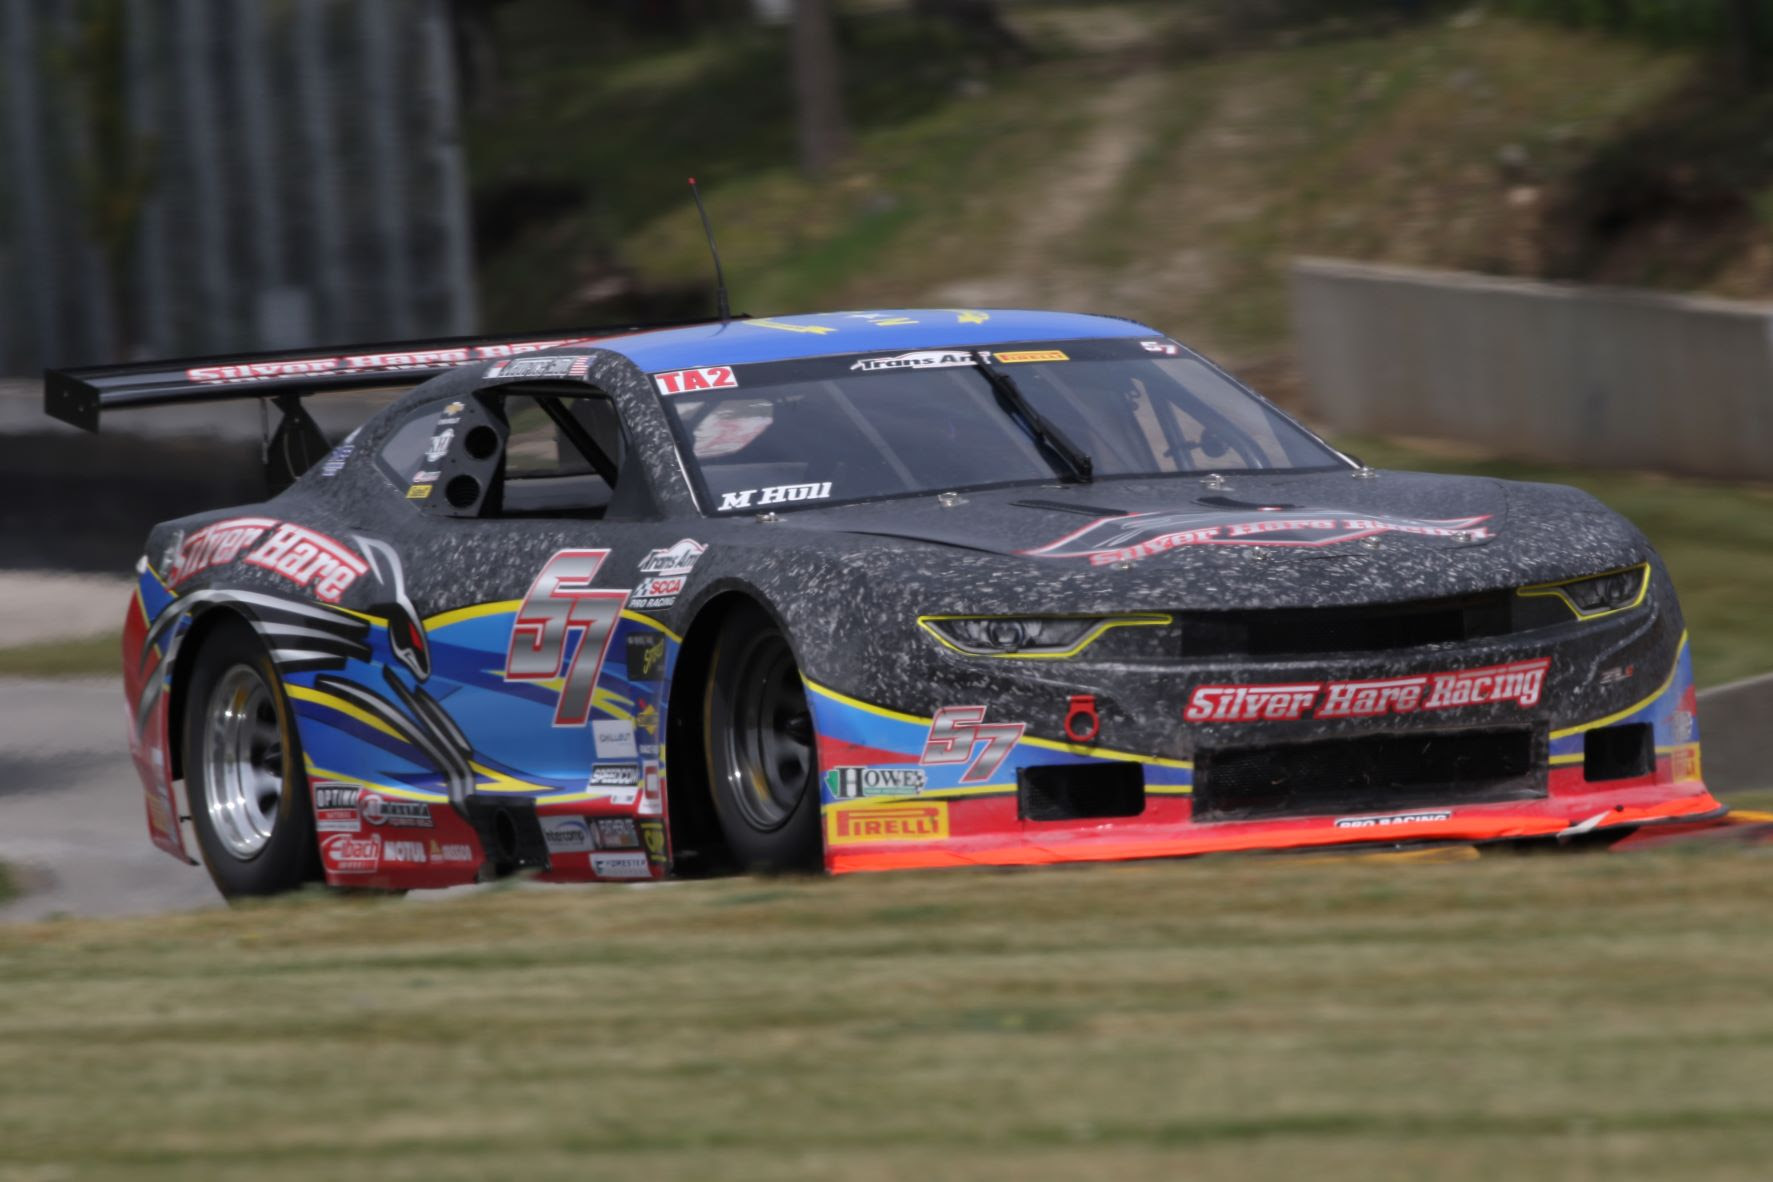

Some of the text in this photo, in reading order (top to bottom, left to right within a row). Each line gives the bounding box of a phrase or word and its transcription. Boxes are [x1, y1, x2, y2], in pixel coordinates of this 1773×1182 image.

[1140, 341, 1177, 355] 57
[186, 358, 337, 381] Silver
[854, 357, 937, 371] Trans
[656, 367, 736, 393] TA2
[717, 481, 833, 511] M Hull
[1089, 526, 1221, 566] Silver
[167, 518, 371, 603] Silver Hare
[642, 549, 700, 571] Trans Am
[650, 579, 682, 595] SCCA
[629, 596, 677, 609] PRO RACING
[504, 549, 632, 727] 57
[1184, 656, 1550, 722] Silver Hare Racing
[919, 705, 1026, 784] 57
[836, 807, 940, 837] PIRELLI
[384, 841, 426, 862] MOTUL
